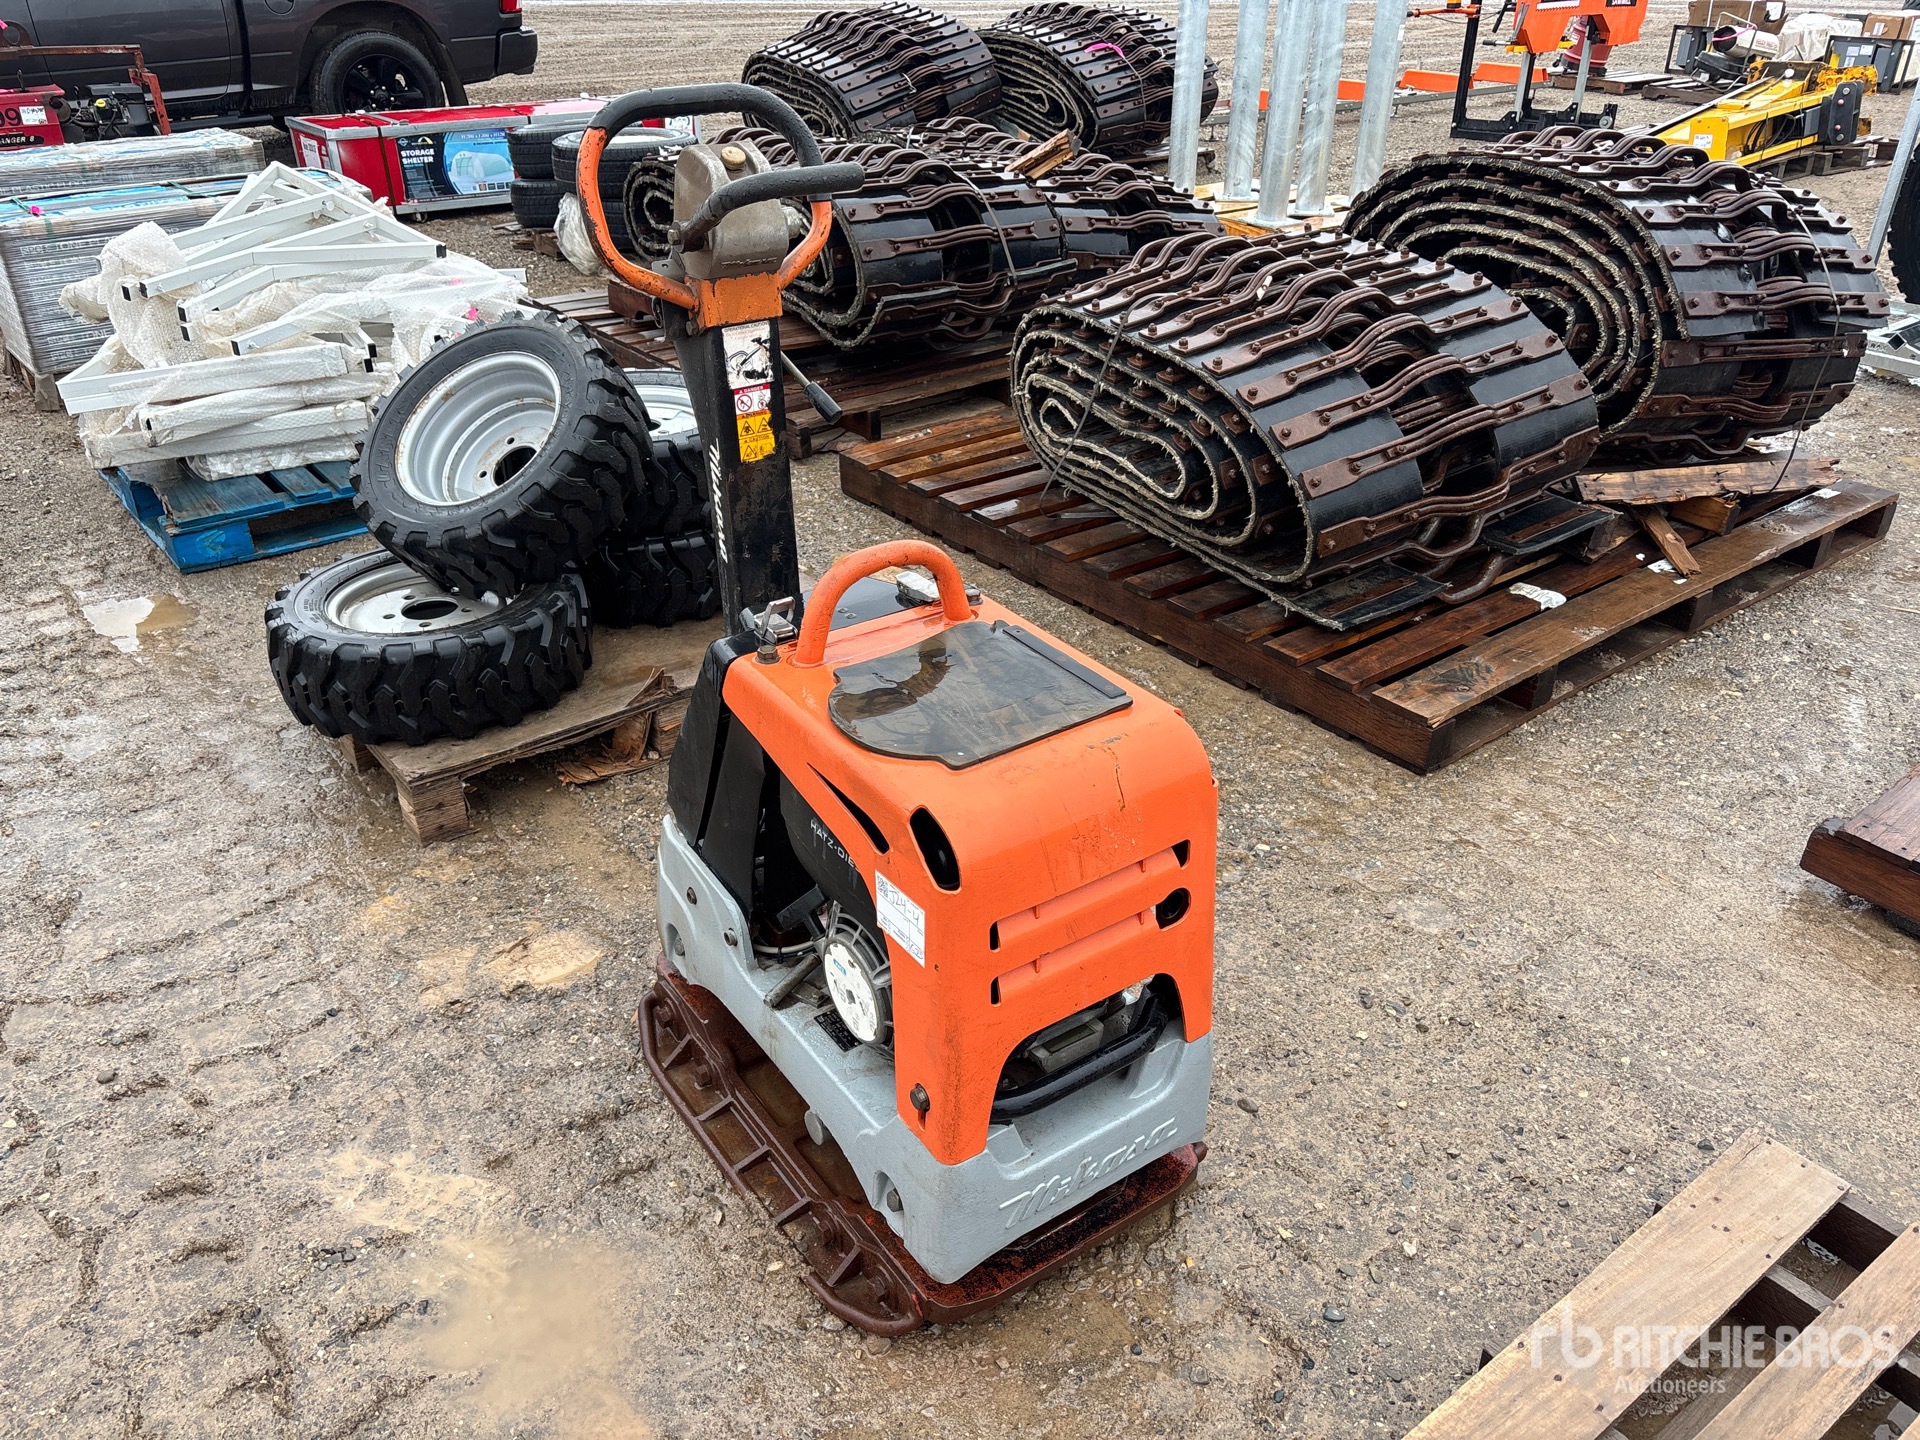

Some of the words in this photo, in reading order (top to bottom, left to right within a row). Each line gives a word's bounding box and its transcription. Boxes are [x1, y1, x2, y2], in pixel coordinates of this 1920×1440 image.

[401, 148, 434, 157] STORAGE
[402, 156, 434, 164] SHELTER
[744, 385, 764, 393] DANGER
